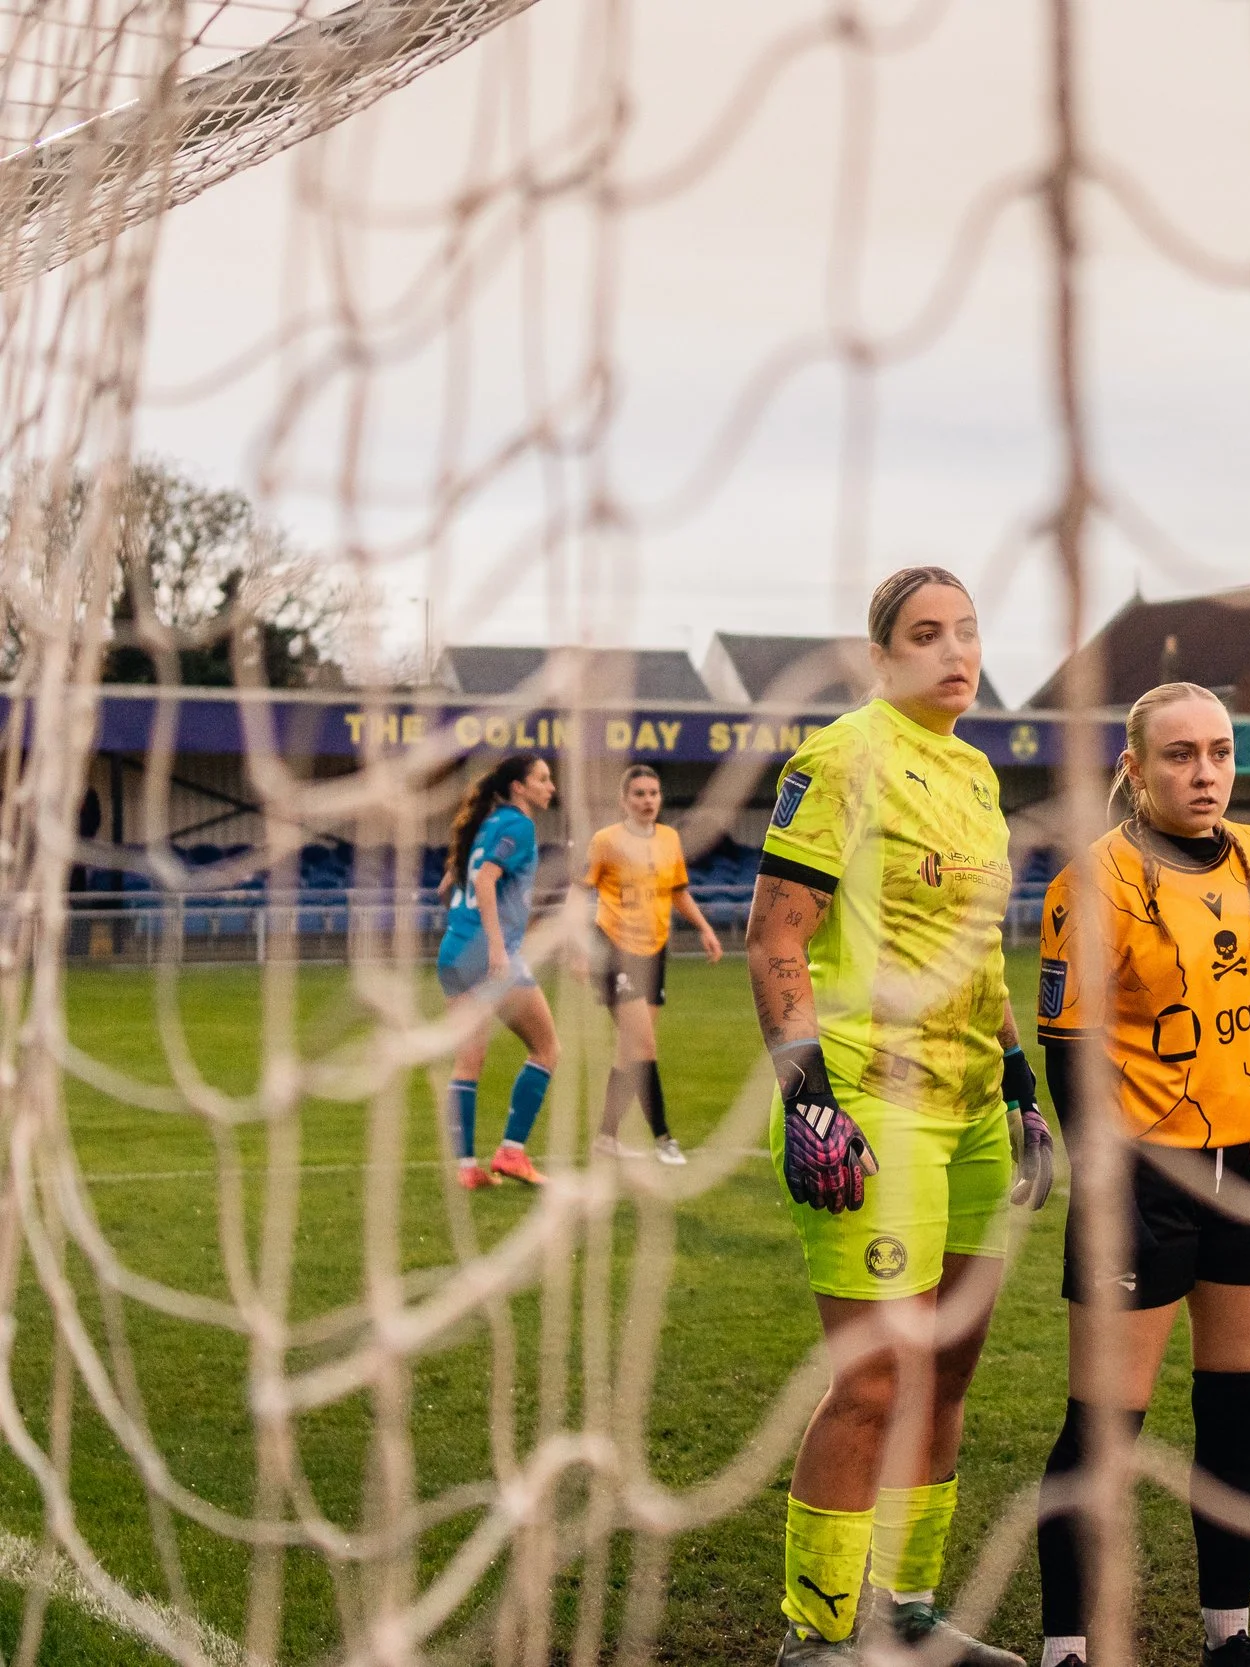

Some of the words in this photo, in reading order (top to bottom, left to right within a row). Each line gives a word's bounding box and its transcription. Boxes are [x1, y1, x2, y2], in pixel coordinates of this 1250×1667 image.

[344, 713, 426, 745] THE
[455, 715, 571, 748] COLIN
[605, 720, 682, 751] DAY
[941, 852, 976, 865] NEXT
